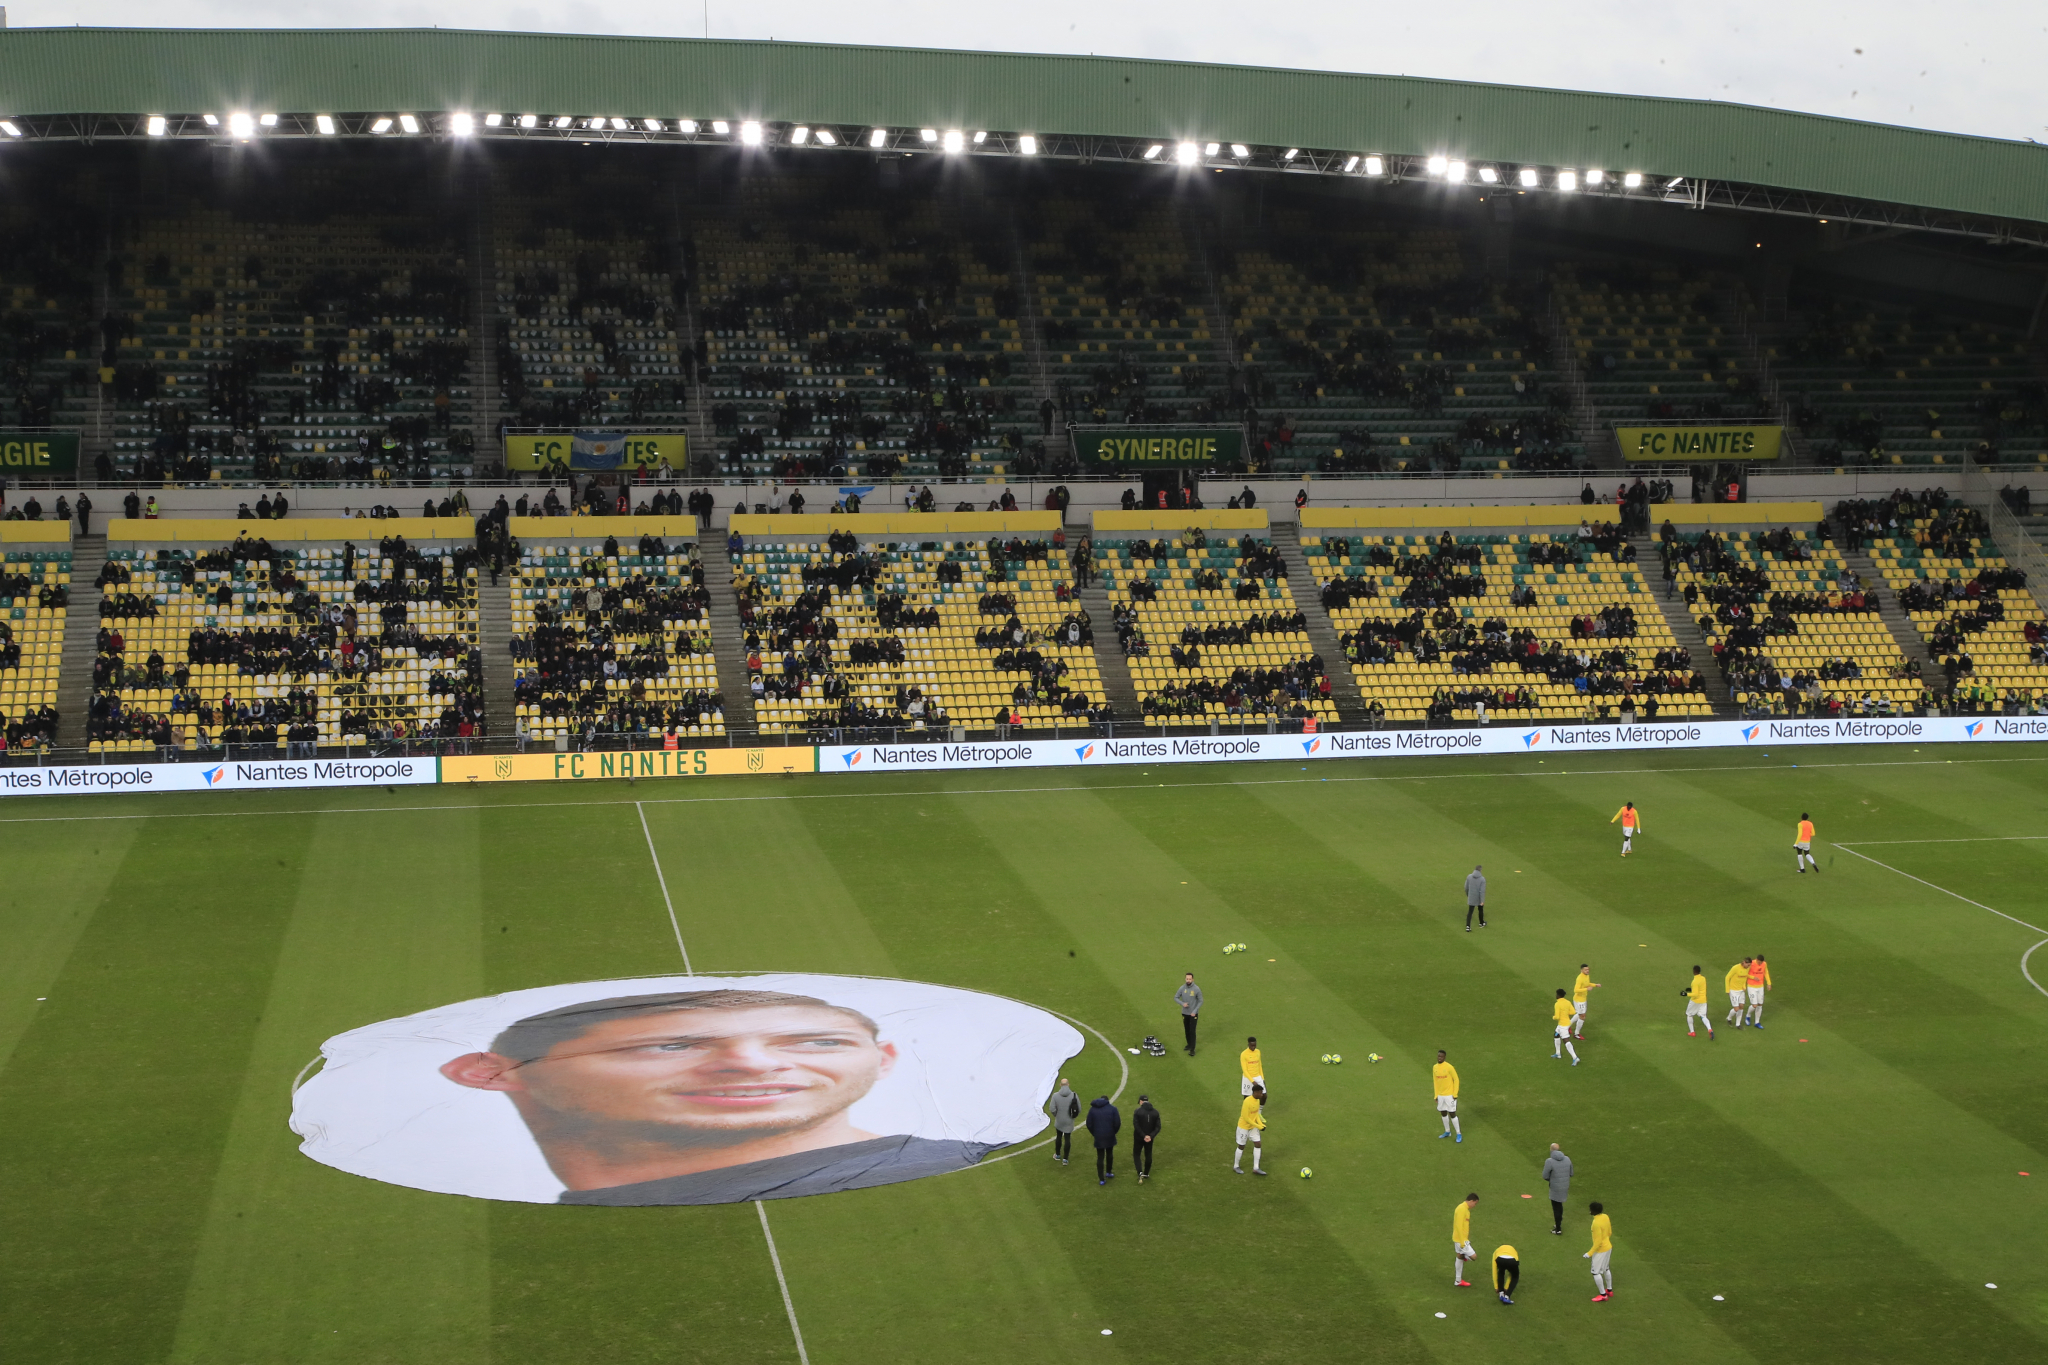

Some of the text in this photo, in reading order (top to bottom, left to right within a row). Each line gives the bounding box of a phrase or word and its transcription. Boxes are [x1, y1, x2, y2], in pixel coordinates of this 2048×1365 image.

[1099, 437, 1216, 461] SYNERGIE
[1639, 431, 1755, 454] FC NANTES
[0, 441, 50, 466] GIE
[533, 441, 562, 464] FC
[1551, 728, 1611, 744] Nantes
[1770, 722, 1830, 738] Nantes
[1994, 719, 2048, 735] Nante
[1105, 740, 1168, 757] Nantes
[1331, 733, 1390, 750] Nantes
[555, 750, 707, 779] FC NANTES
[873, 747, 938, 764] Nantes
[236, 761, 308, 783] Nantes
